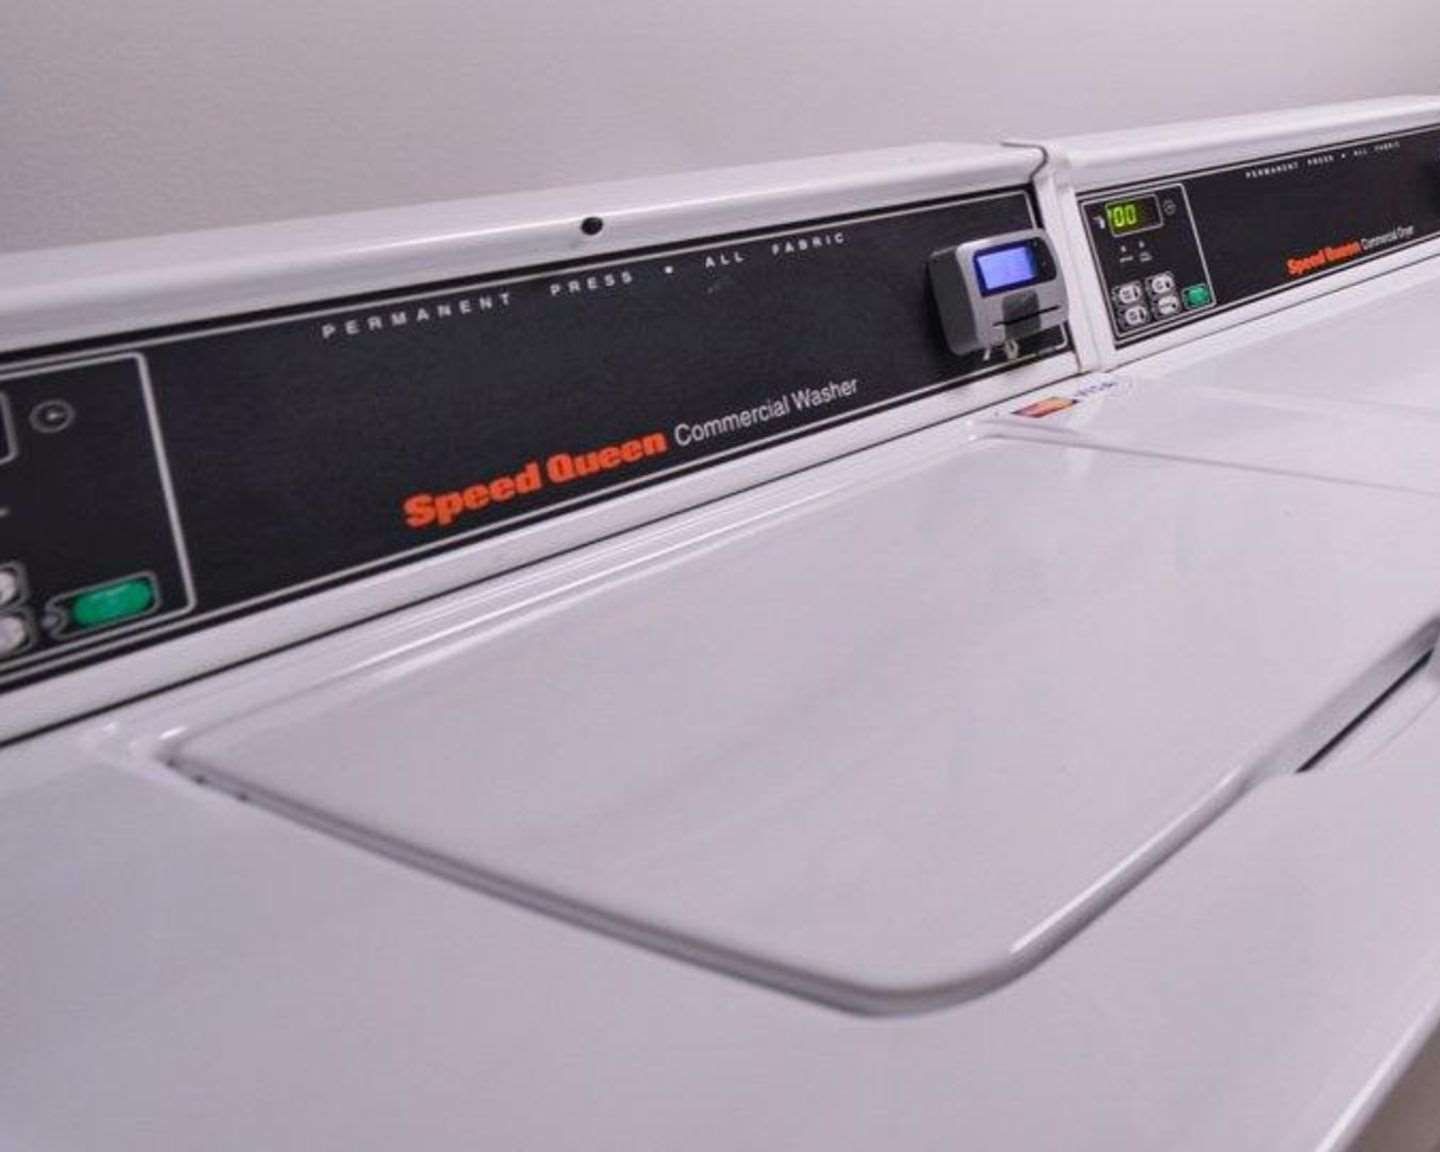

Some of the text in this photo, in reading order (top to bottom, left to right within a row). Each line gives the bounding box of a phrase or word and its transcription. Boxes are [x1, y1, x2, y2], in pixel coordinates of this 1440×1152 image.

[321, 232, 846, 339] PERMANENT PRESS ALL FABRIC
[403, 375, 860, 528] Speed Queen Commercial Washer
